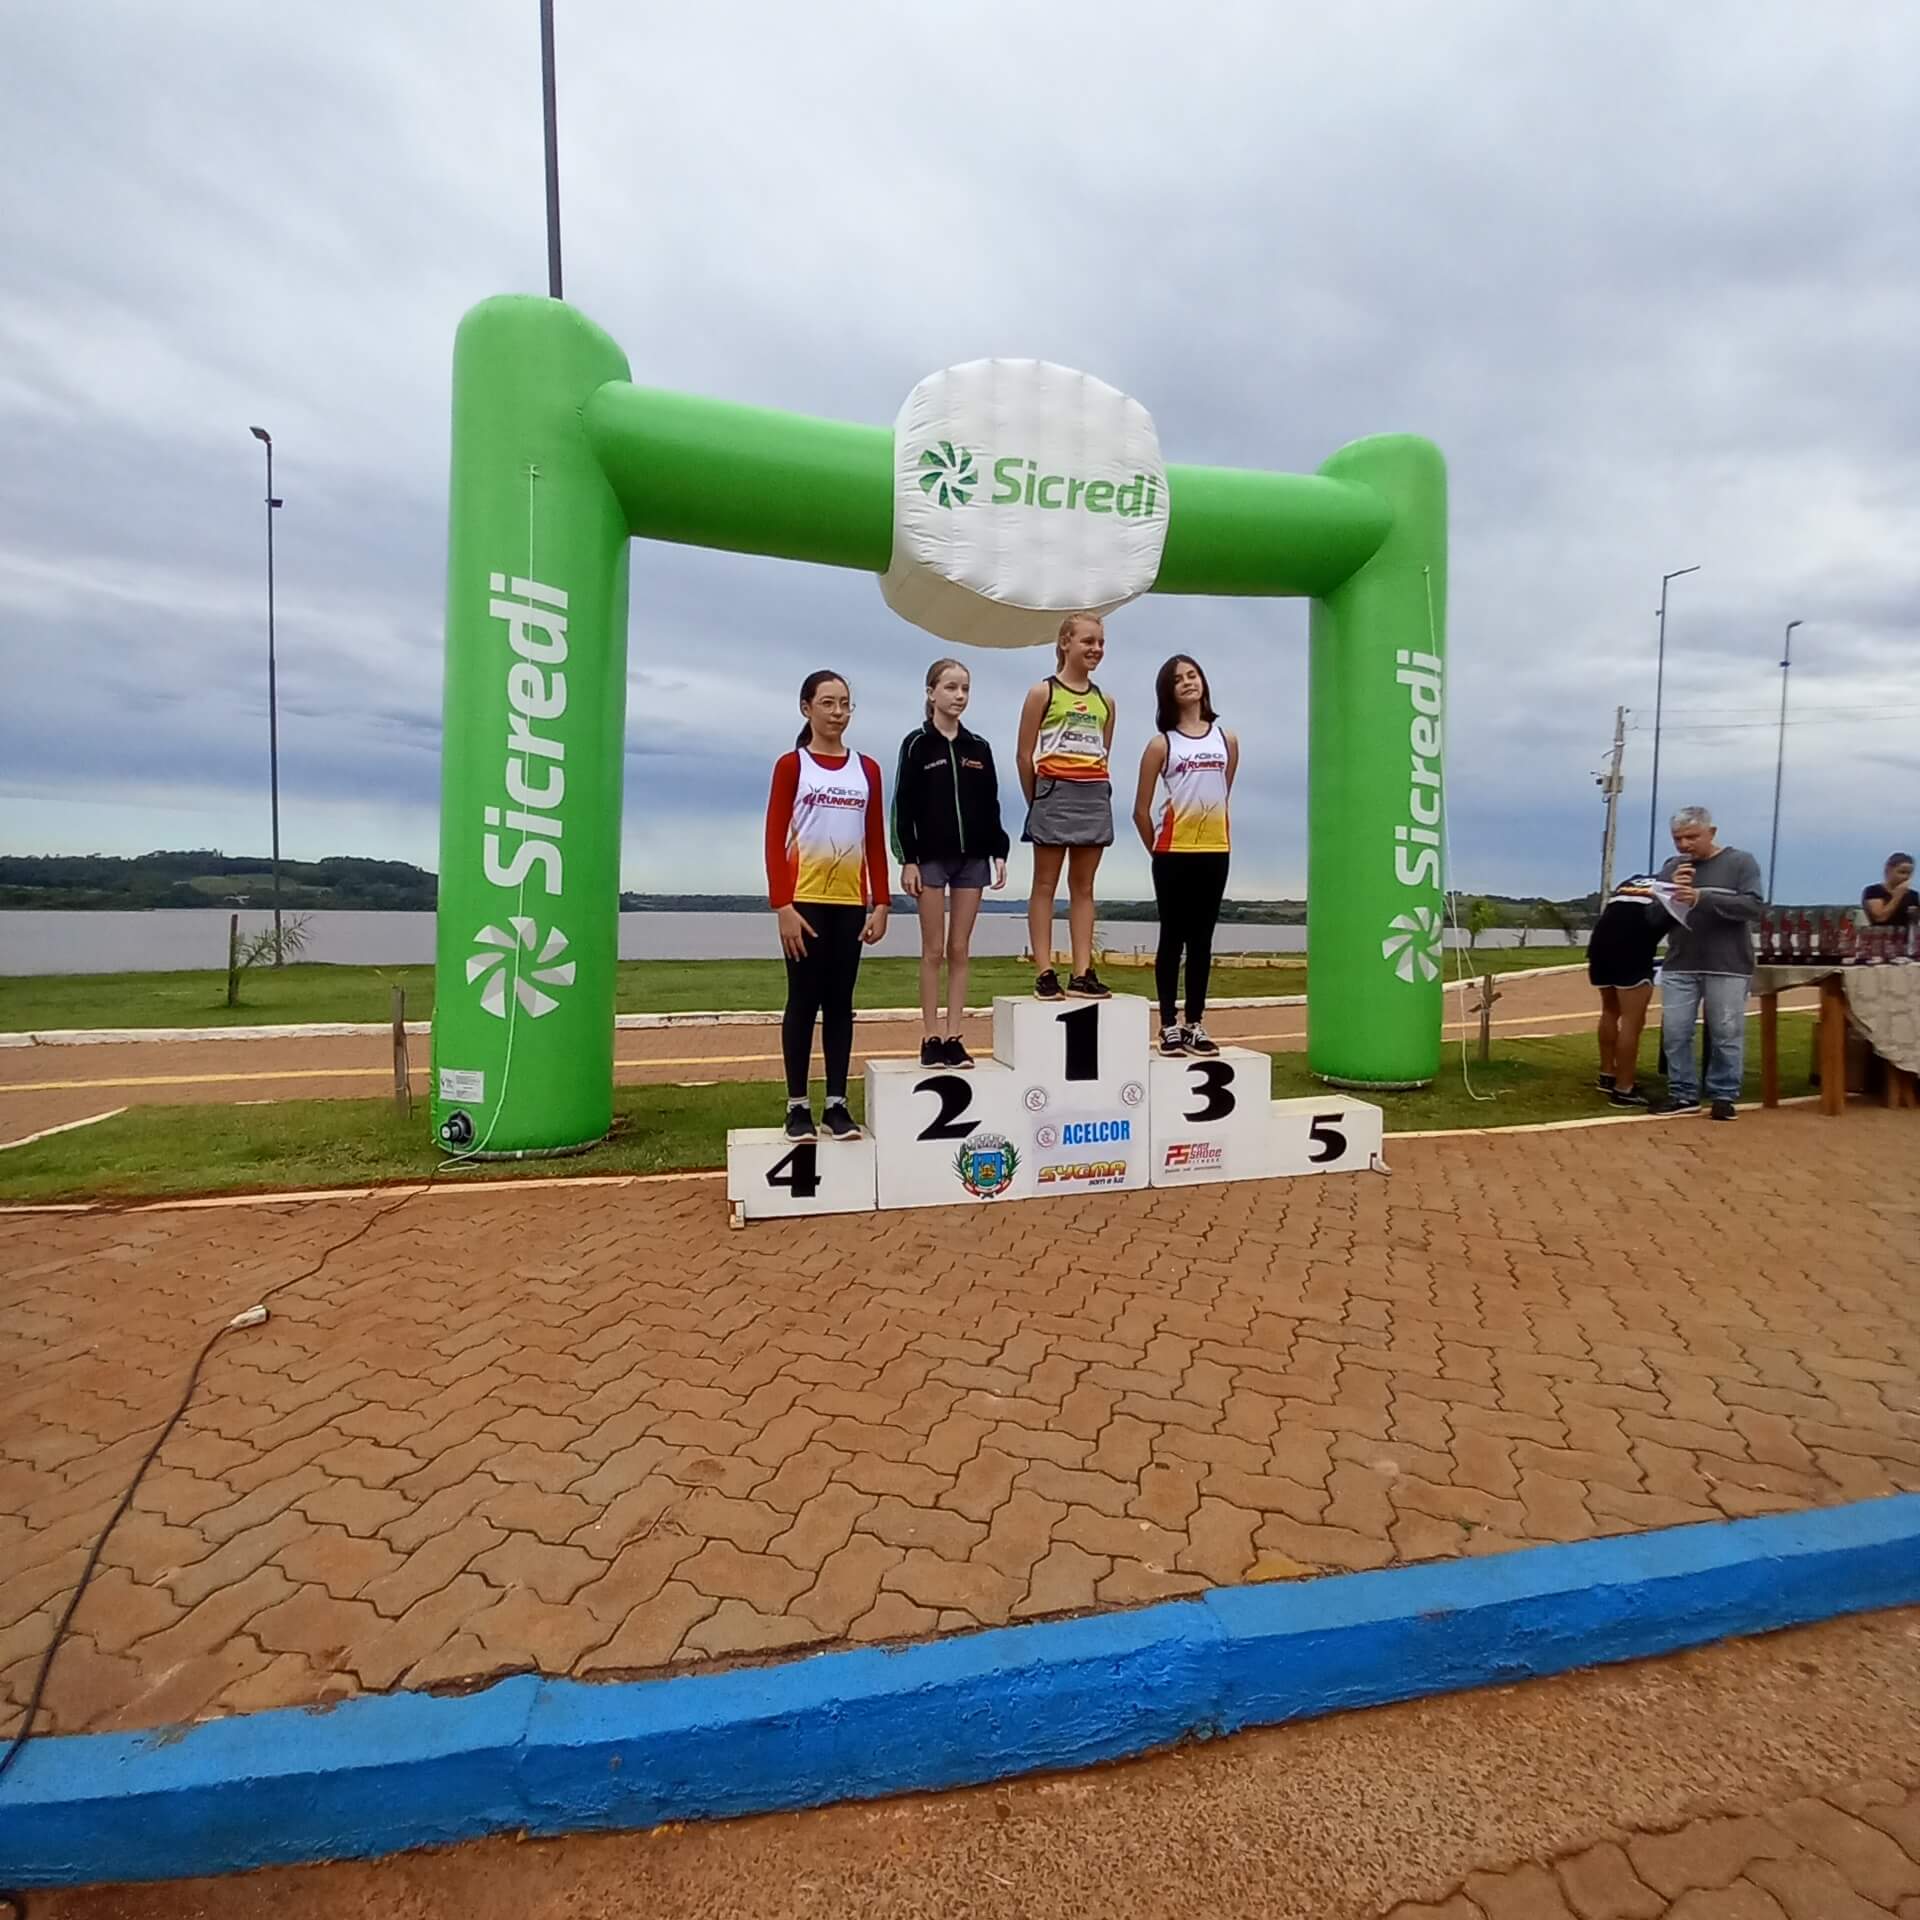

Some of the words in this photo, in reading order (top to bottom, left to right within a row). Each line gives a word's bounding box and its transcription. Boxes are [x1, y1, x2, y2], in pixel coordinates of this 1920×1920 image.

[992, 457, 1158, 518] Sicredi
[484, 572, 568, 895] Sicredi
[1395, 649, 1442, 890] Sicredi
[1056, 1004, 1098, 1080] 1
[914, 1076, 982, 1140] 2
[1184, 1061, 1235, 1122] 3
[1062, 1120, 1130, 1145] ACELCOR
[1309, 1114, 1346, 1162] 5
[766, 1143, 821, 1197] 4
[1038, 1160, 1126, 1183] SYGMA
